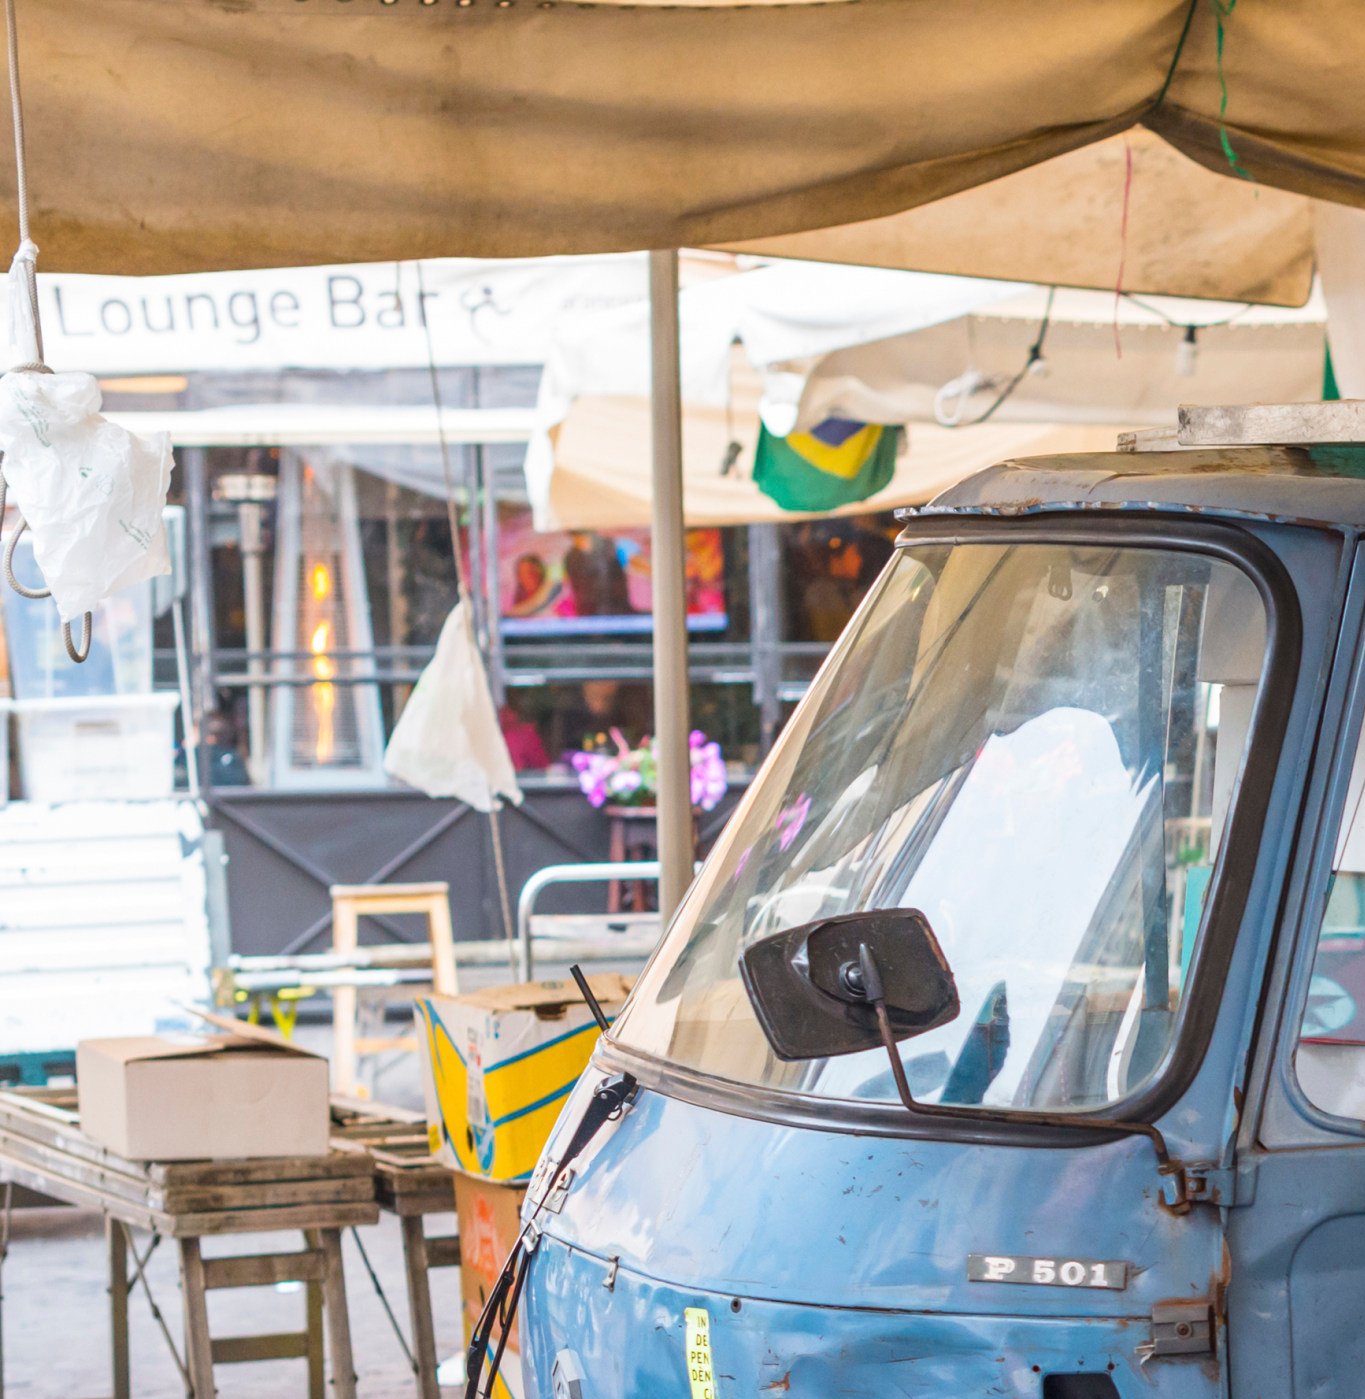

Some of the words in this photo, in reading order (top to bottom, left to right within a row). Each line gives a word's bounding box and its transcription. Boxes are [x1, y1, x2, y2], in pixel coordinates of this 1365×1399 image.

[53, 285, 301, 344] Lounge
[327, 275, 439, 329] Bar
[983, 1256, 1016, 1280] P
[1033, 1259, 1109, 1287] 501
[698, 1316, 706, 1328] IN
[696, 1334, 708, 1347] DE
[691, 1351, 709, 1364] PEN
